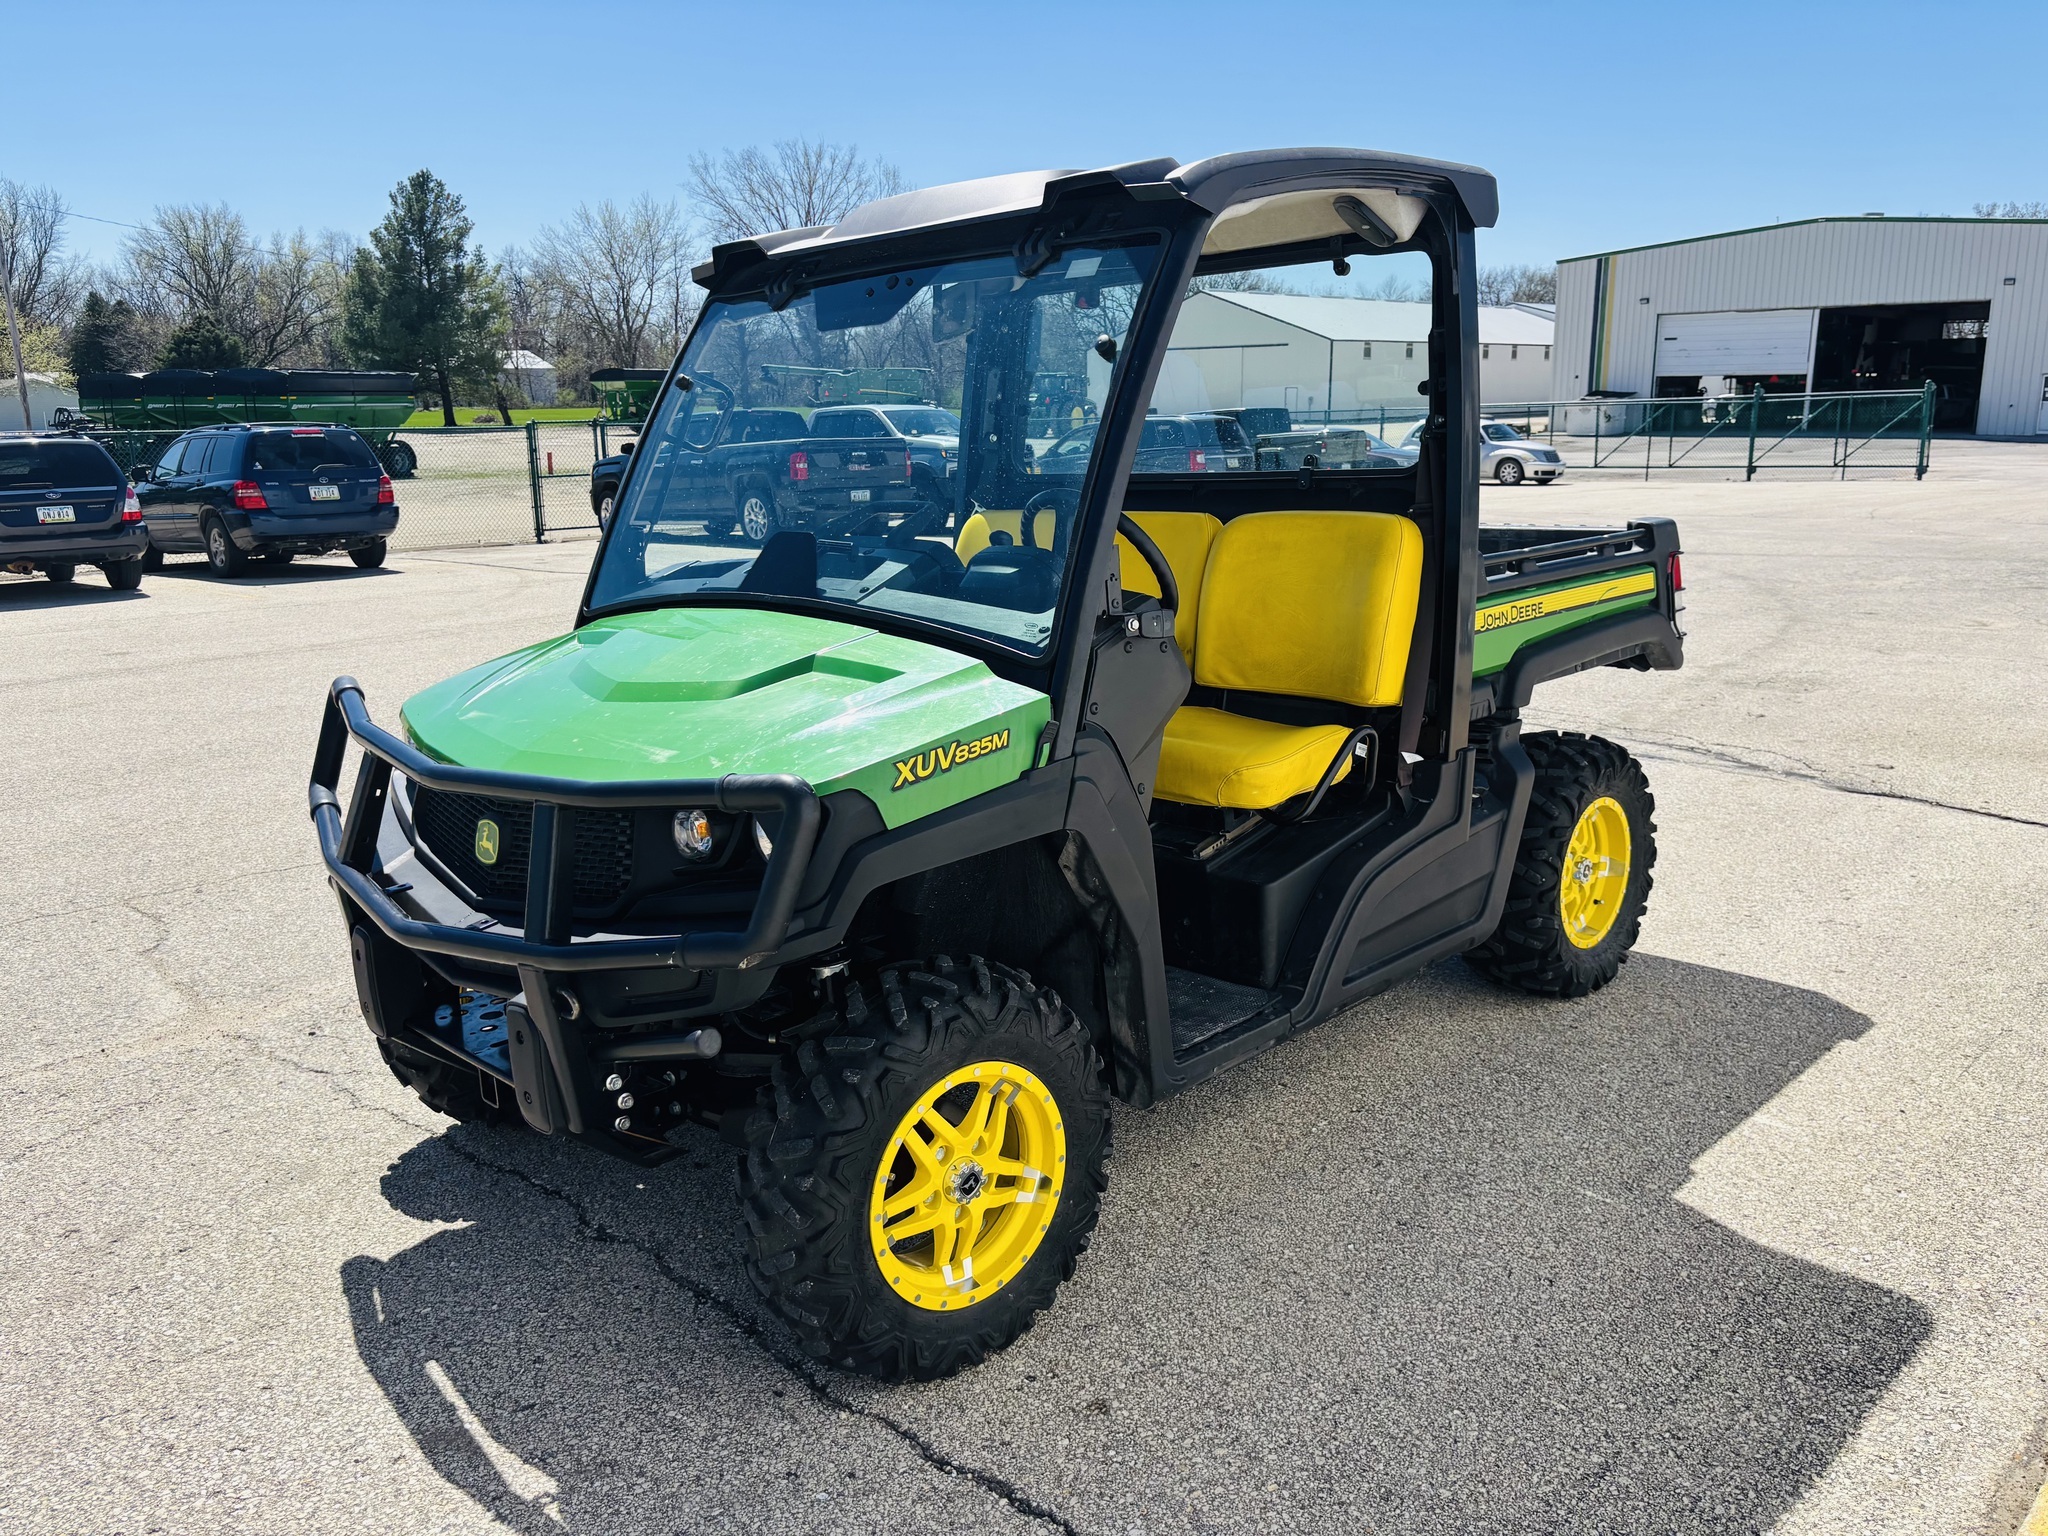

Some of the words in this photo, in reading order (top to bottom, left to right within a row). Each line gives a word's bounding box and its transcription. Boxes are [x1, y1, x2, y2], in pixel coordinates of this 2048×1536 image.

[1480, 610, 1509, 629] JOHN
[1510, 601, 1544, 621] DEERE
[892, 728, 1010, 790] XUV835M
